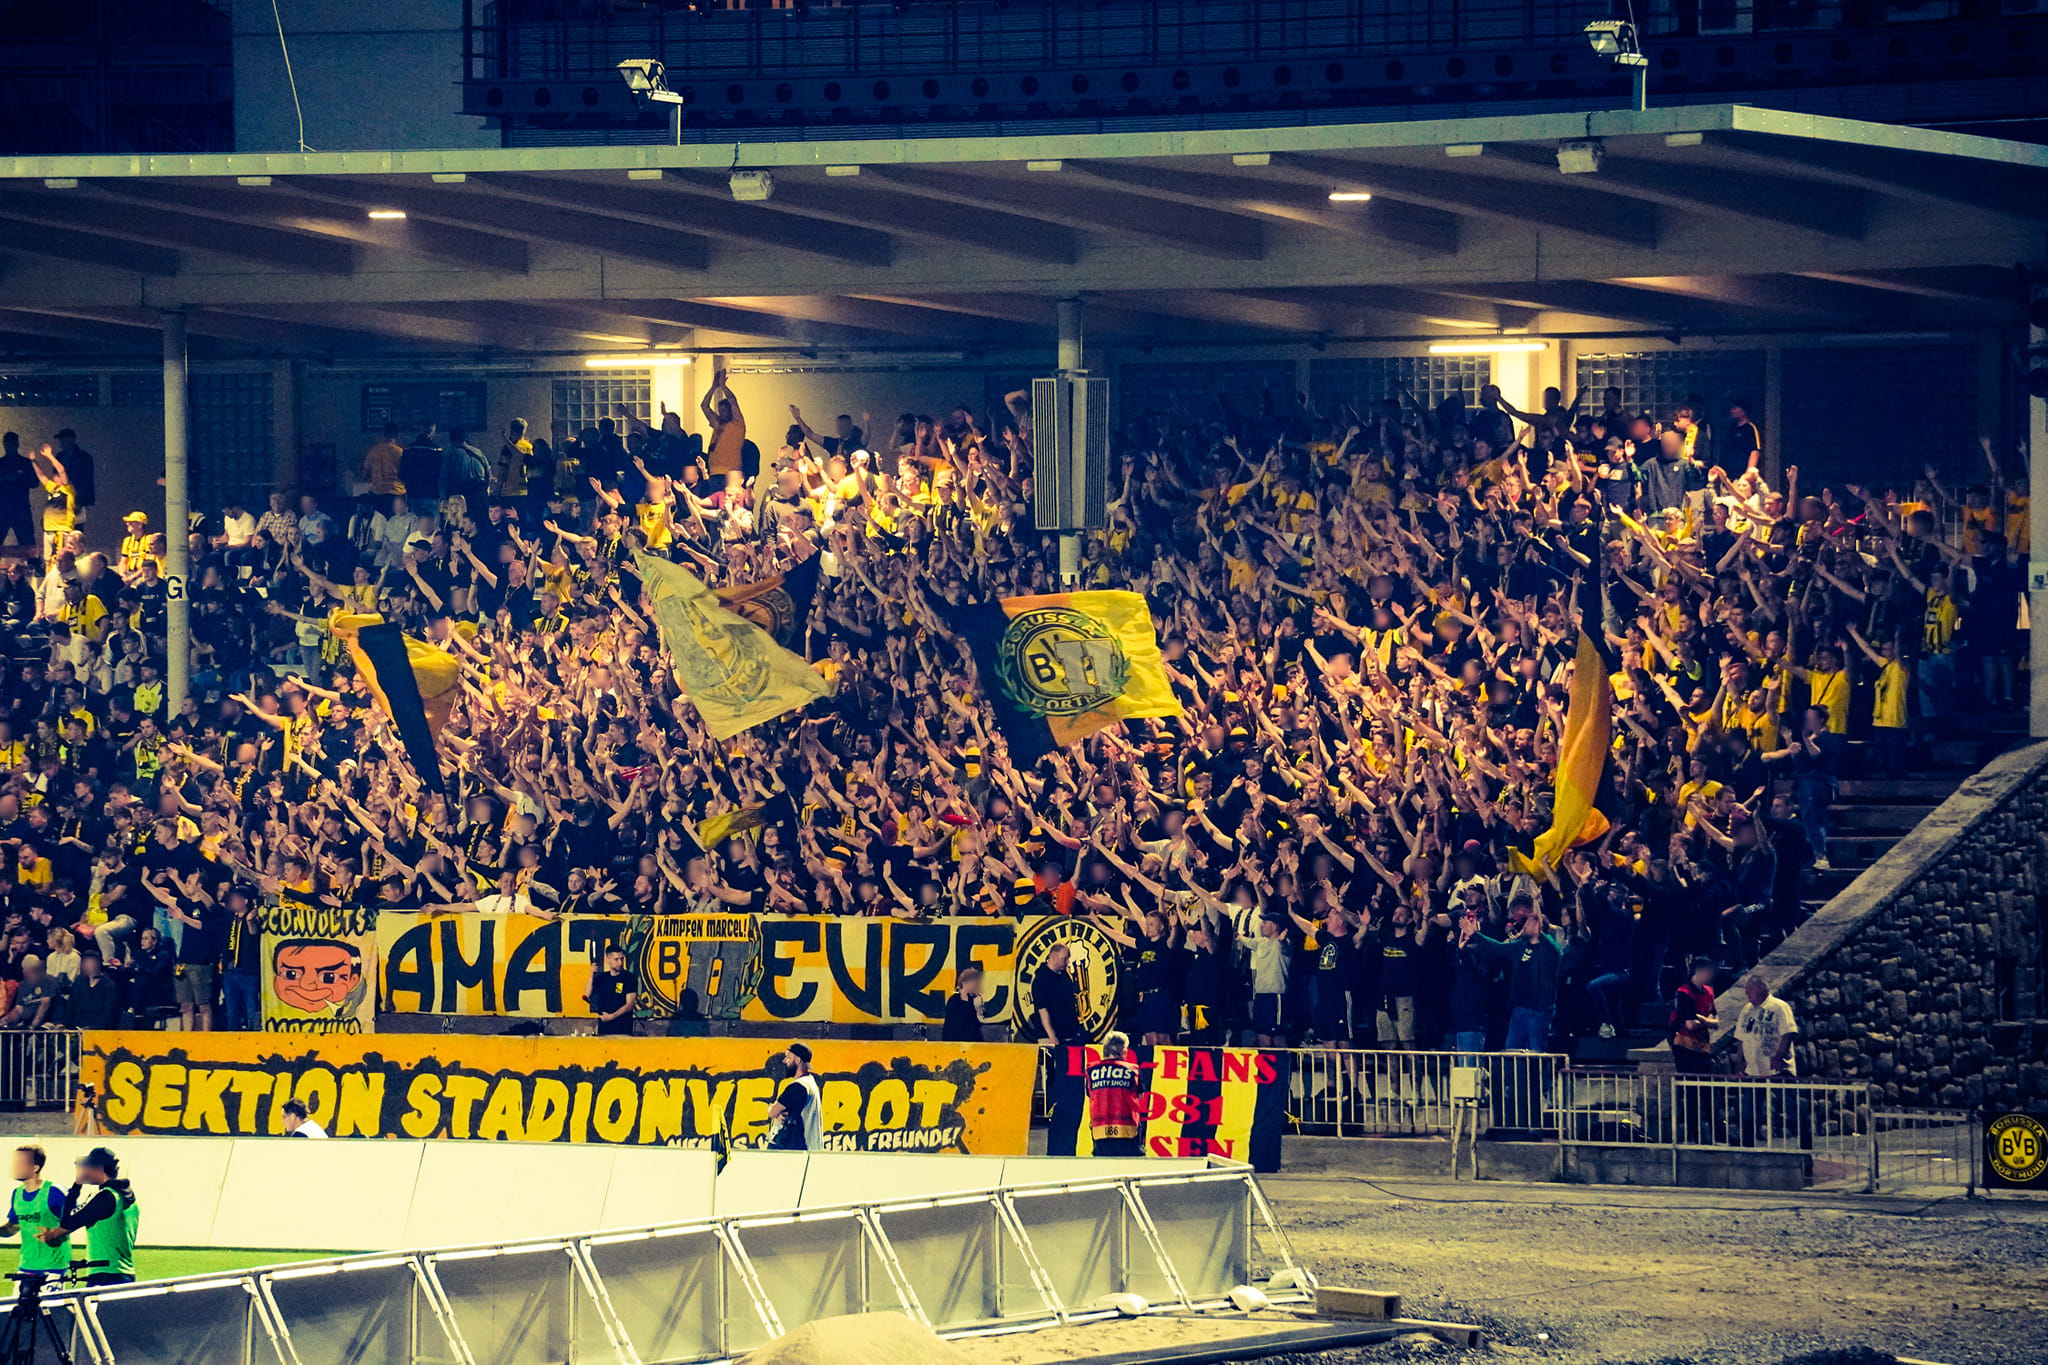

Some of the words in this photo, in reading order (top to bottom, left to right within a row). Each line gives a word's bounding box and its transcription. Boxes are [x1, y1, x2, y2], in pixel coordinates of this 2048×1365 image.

[167, 576, 182, 599] G
[1091, 1066, 1132, 1081] atlas
[105, 1060, 386, 1137] SEKTION
[400, 1072, 959, 1144] STADIONVEBOT
[1139, 1091, 1224, 1126] 981
[1991, 1116, 2043, 1137] BORUSSIA
[868, 1127, 962, 1151] FREUNDE!
[2003, 1131, 2035, 1156] BVB
[1993, 1160, 2045, 1179] DORTMUND
